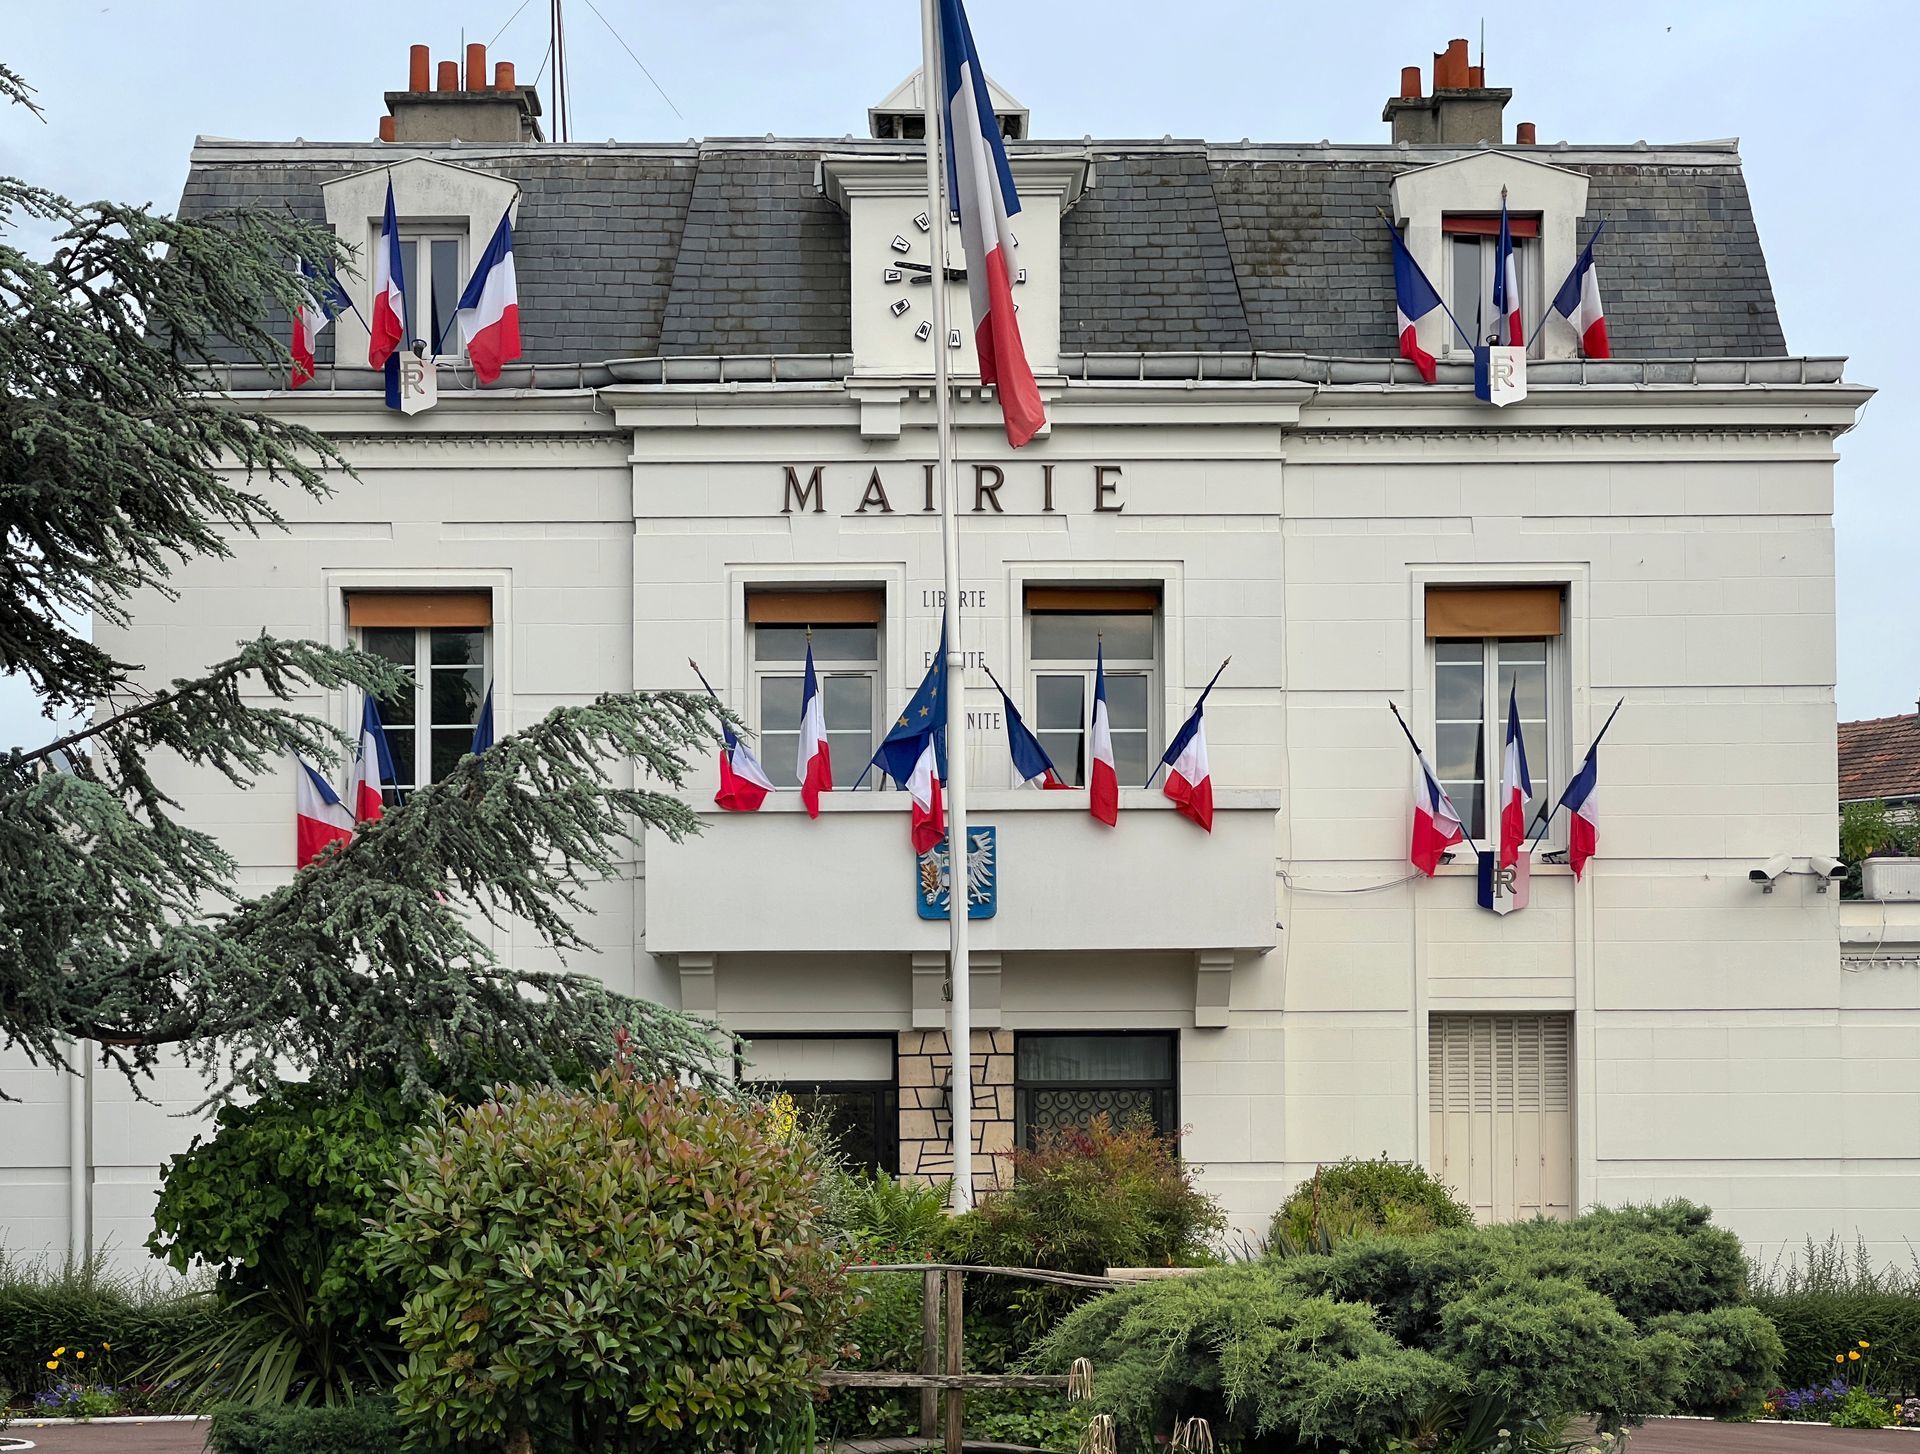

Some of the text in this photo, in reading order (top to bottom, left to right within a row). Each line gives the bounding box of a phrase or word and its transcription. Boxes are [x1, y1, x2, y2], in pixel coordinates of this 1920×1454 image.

[780, 464, 1126, 512] MAIRIE
[922, 590, 986, 608] LIBRTE
[924, 651, 985, 669] EITE
